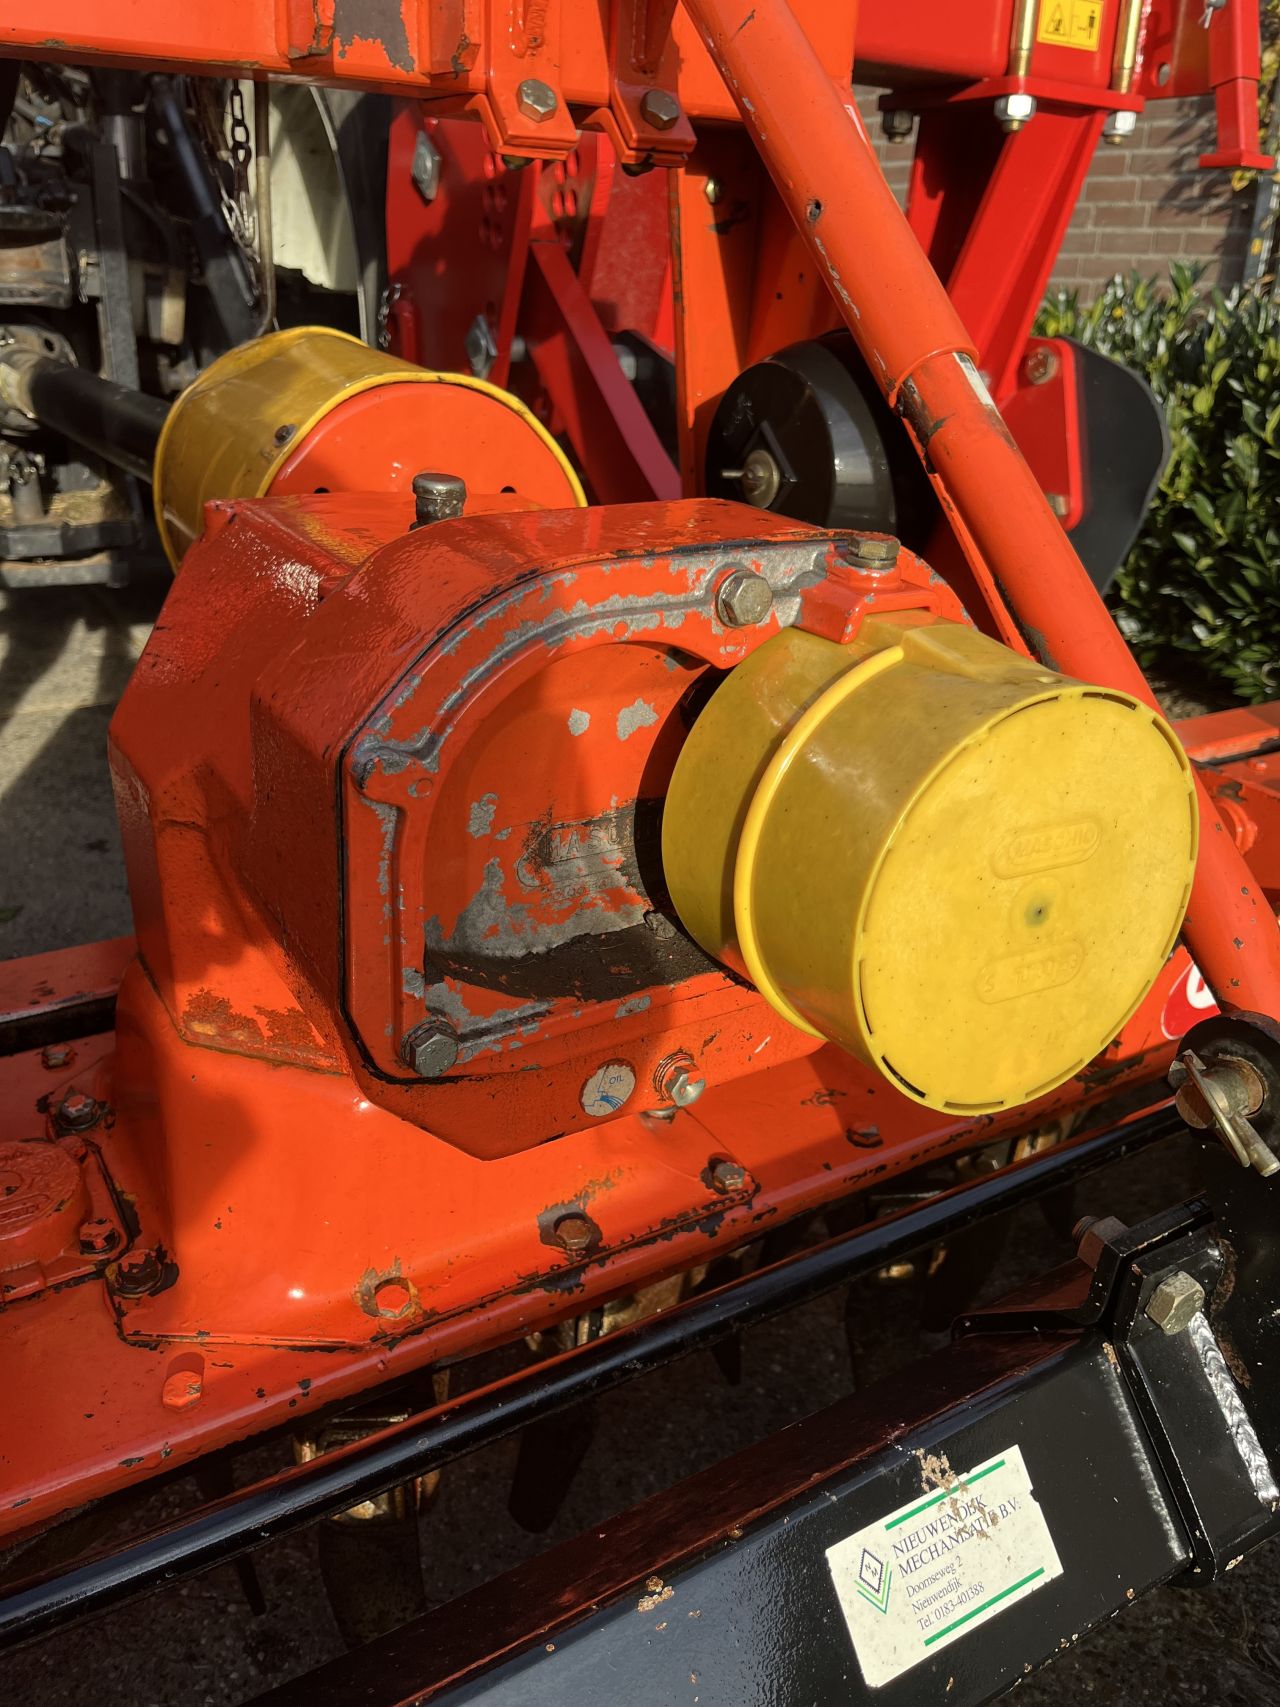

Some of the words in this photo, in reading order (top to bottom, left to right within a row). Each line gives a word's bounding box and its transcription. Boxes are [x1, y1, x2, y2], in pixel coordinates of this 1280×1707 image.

[608, 1074, 625, 1085] OIL
[998, 1496, 1021, 1519] B.V.
[905, 1562, 957, 1598] Doornseweg
[955, 1555, 963, 1567] 2
[911, 1576, 962, 1614] Nieuwendijk
[916, 1614, 934, 1631] Tel.
[934, 1580, 985, 1621] 0183-401388
